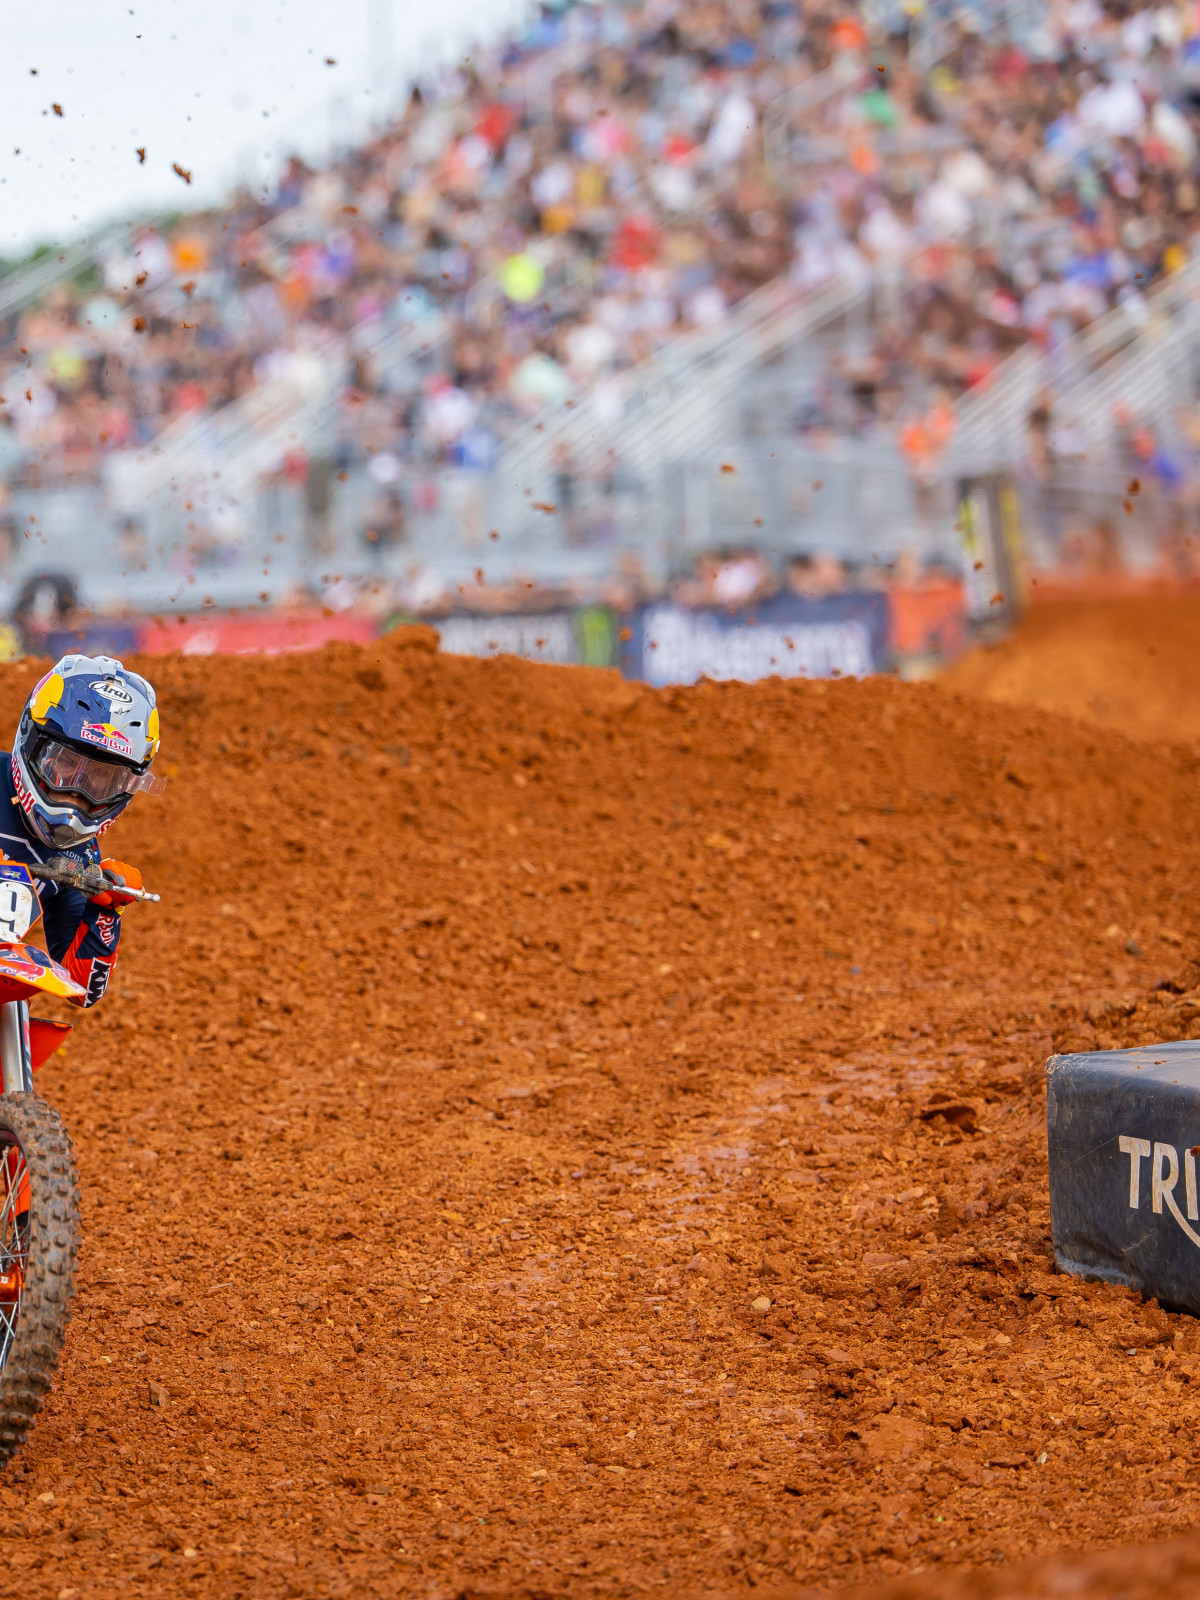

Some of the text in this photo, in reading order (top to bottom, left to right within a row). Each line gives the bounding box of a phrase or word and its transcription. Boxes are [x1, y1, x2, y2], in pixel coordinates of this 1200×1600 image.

[100, 683, 129, 700] Arai
[81, 729, 132, 756] Red Bull
